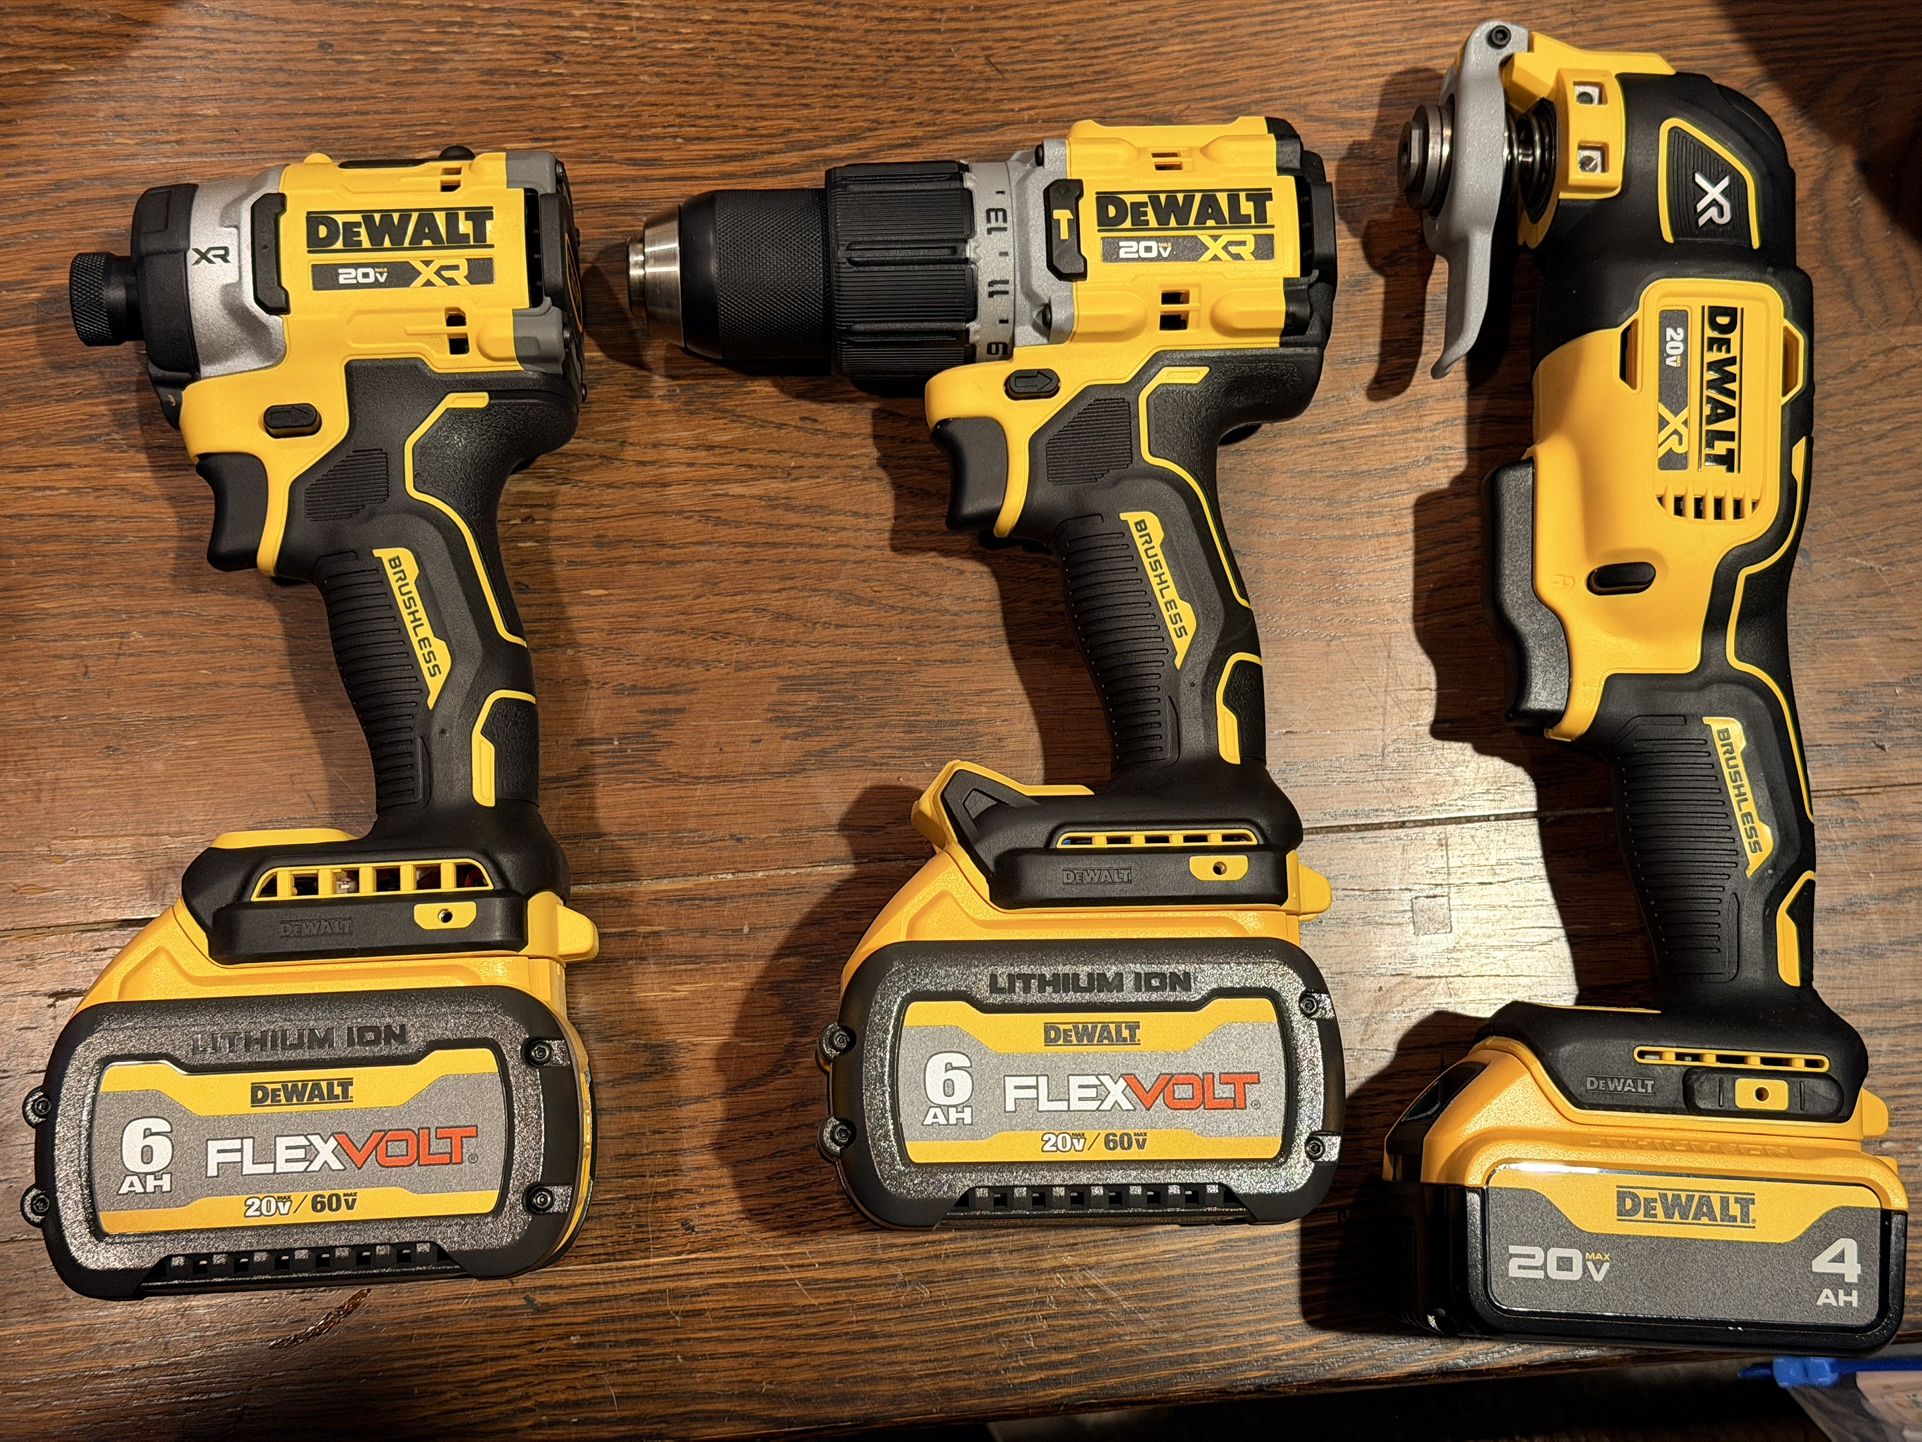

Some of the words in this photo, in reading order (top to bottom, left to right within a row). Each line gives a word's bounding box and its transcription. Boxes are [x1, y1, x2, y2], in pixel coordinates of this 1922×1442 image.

[1096, 192, 1273, 228] DEWALT
[1695, 172, 1731, 228] XR
[305, 211, 494, 248] DEWALT
[986, 207, 1008, 235] 13
[191, 246, 231, 265] XR
[1197, 234, 1256, 262] XR
[408, 258, 471, 287] XR
[987, 280, 1010, 298] 11
[1704, 306, 1738, 474] DEWALT
[1658, 401, 1688, 460] XR
[1134, 519, 1188, 639] BRUSHLESS
[388, 555, 442, 678] BRUSHLESS
[1716, 727, 1763, 854] BRUSHLESS
[1062, 867, 1132, 884] DEWALT
[280, 917, 353, 938] DEWALT
[988, 971, 1125, 995] LITHIUM
[1133, 970, 1192, 994] ION
[192, 1026, 335, 1054] LITHIUM
[346, 1024, 407, 1049] ION
[1043, 1021, 1141, 1045] DEWALT
[250, 1079, 354, 1105] DEWALT
[924, 1051, 974, 1106] 6
[1004, 1072, 1261, 1113] FLEXVOLT
[1586, 1076, 1655, 1095] DEWALT
[922, 1106, 973, 1126] AH
[121, 1116, 174, 1173] 6
[206, 1125, 479, 1178] FLEXVOLT
[118, 1173, 172, 1194] AH
[1616, 1188, 1756, 1225] DEWALT
[1508, 1245, 1610, 1282] 20V
[1585, 1252, 1611, 1261] MAX
[1811, 1238, 1862, 1283] 4
[1816, 1289, 1858, 1308] AH
